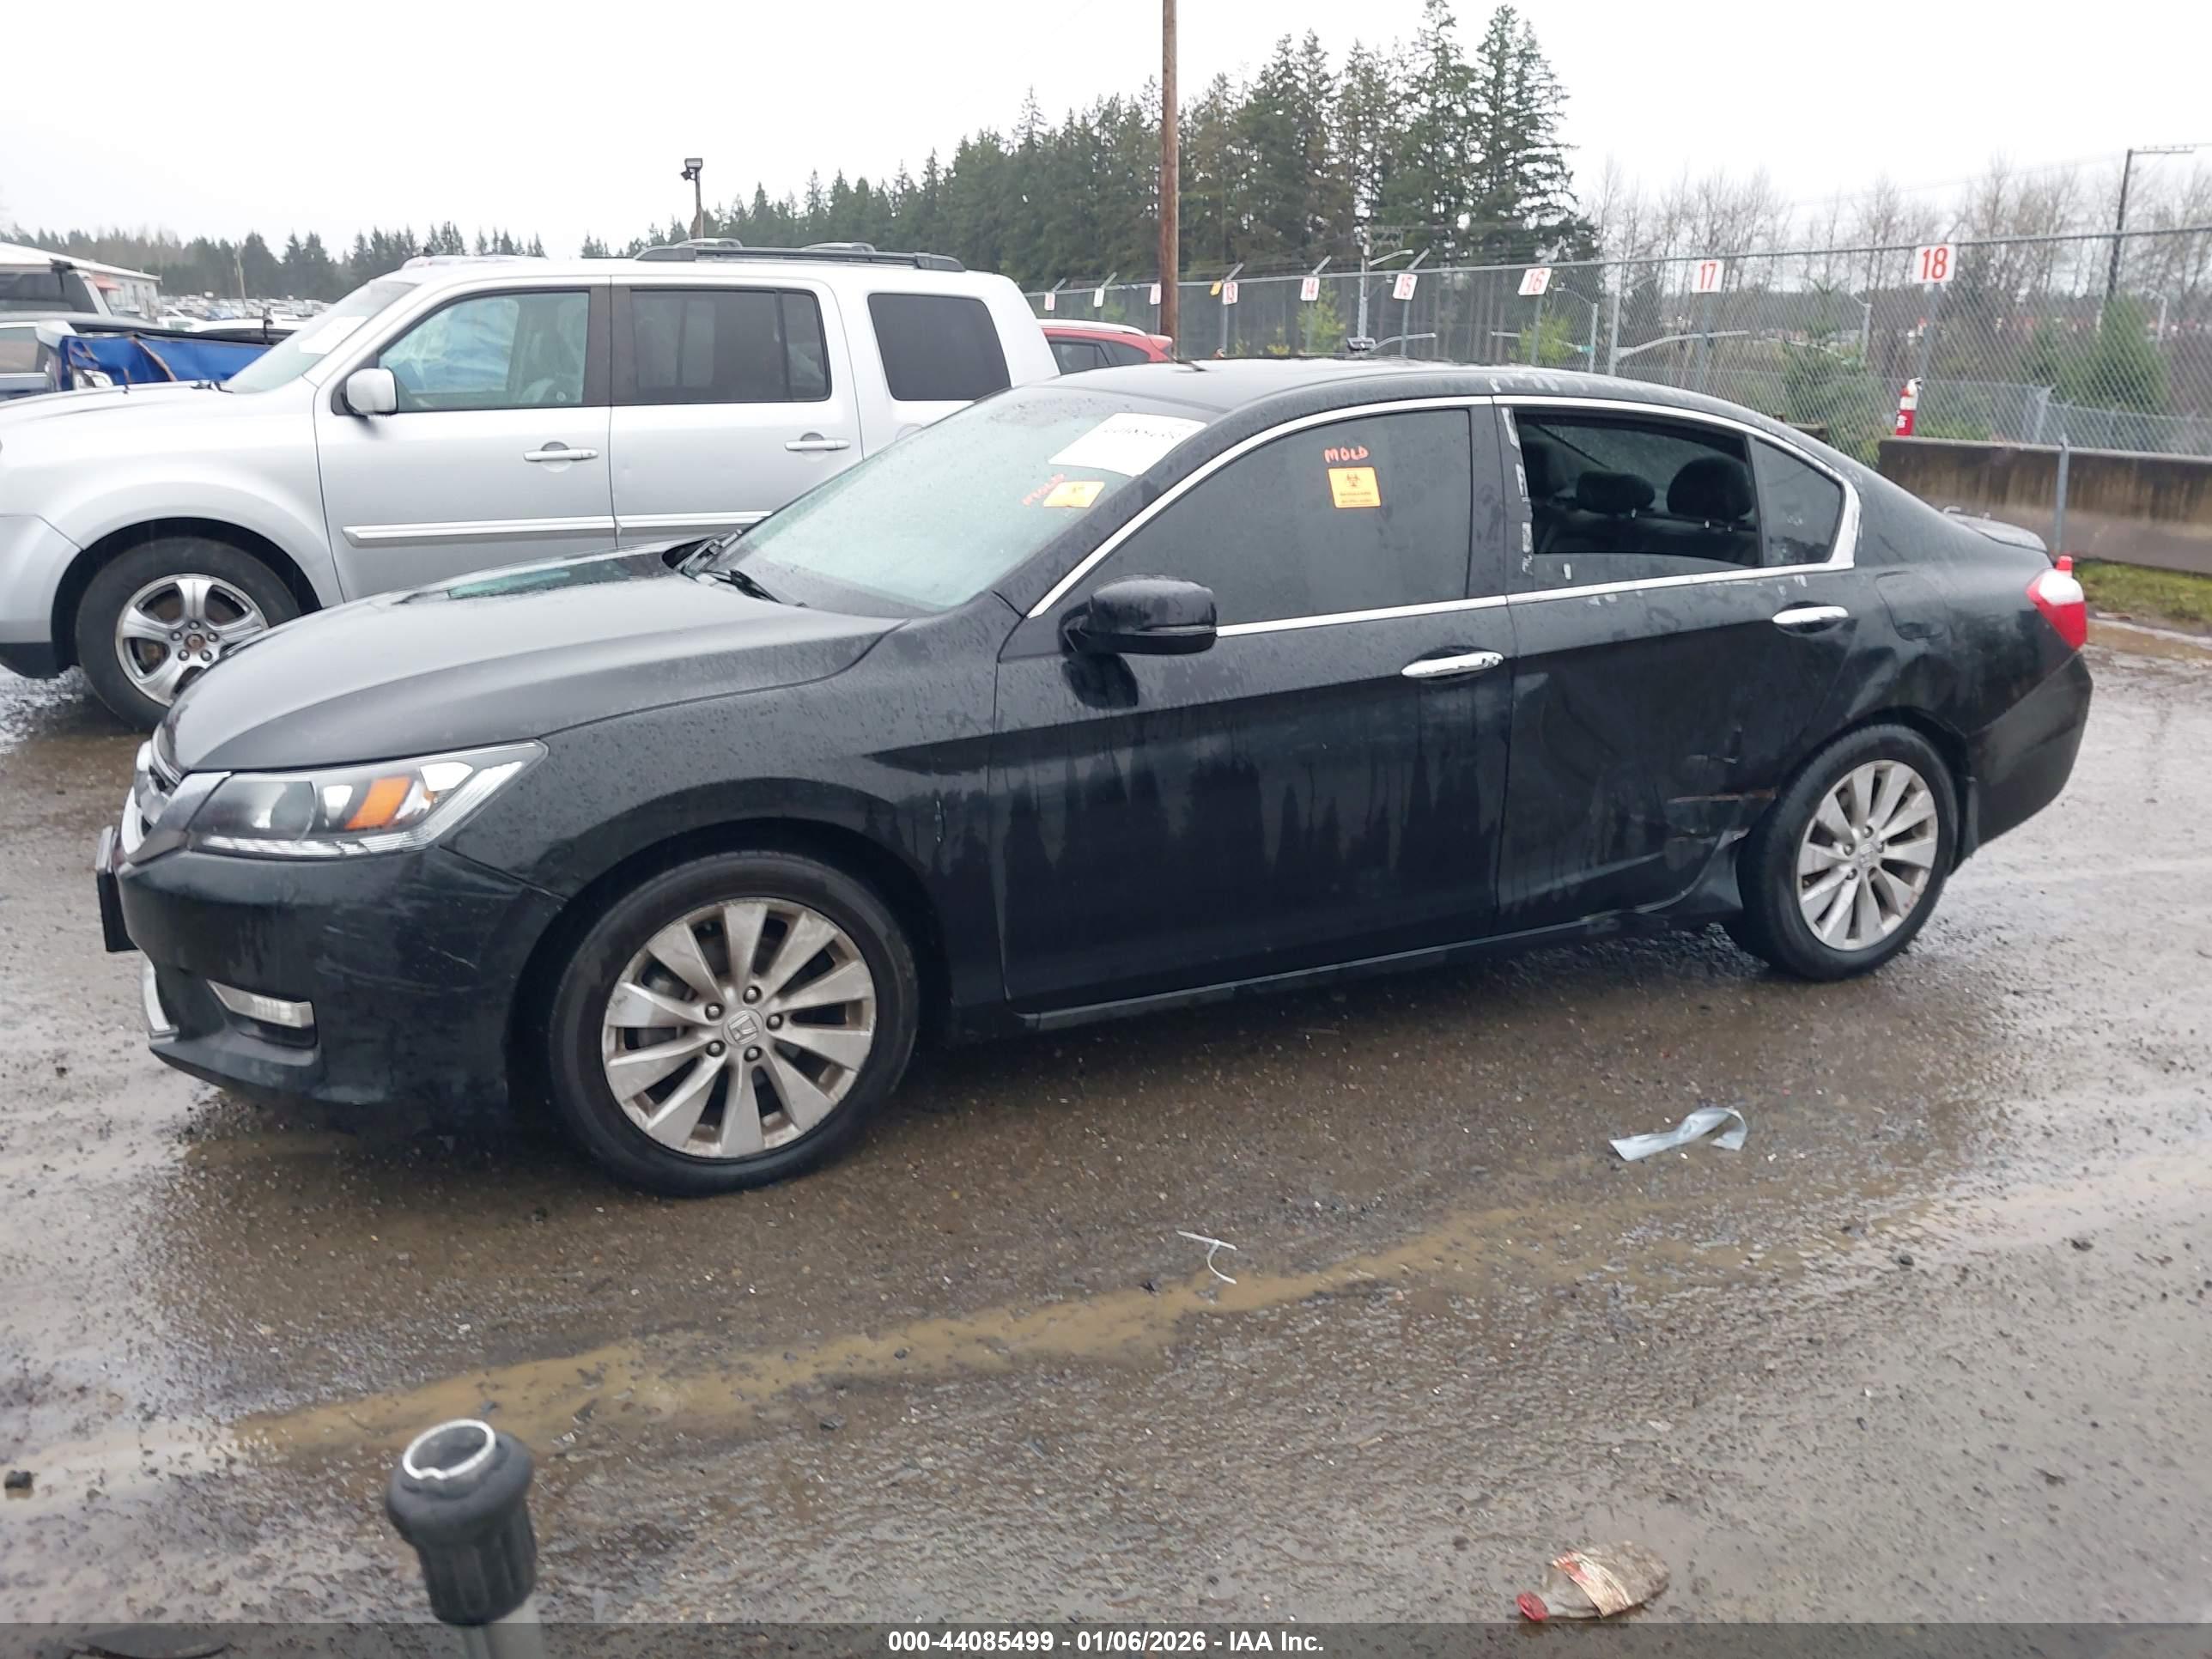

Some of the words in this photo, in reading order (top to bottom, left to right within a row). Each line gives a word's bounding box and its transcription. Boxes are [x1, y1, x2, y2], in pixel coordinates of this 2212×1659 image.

[1699, 262, 1717, 289] 17
[1921, 246, 1949, 280] 18
[1398, 276, 1413, 297] 15
[1526, 269, 1546, 295] 16
[1324, 446, 1369, 464] MOLD
